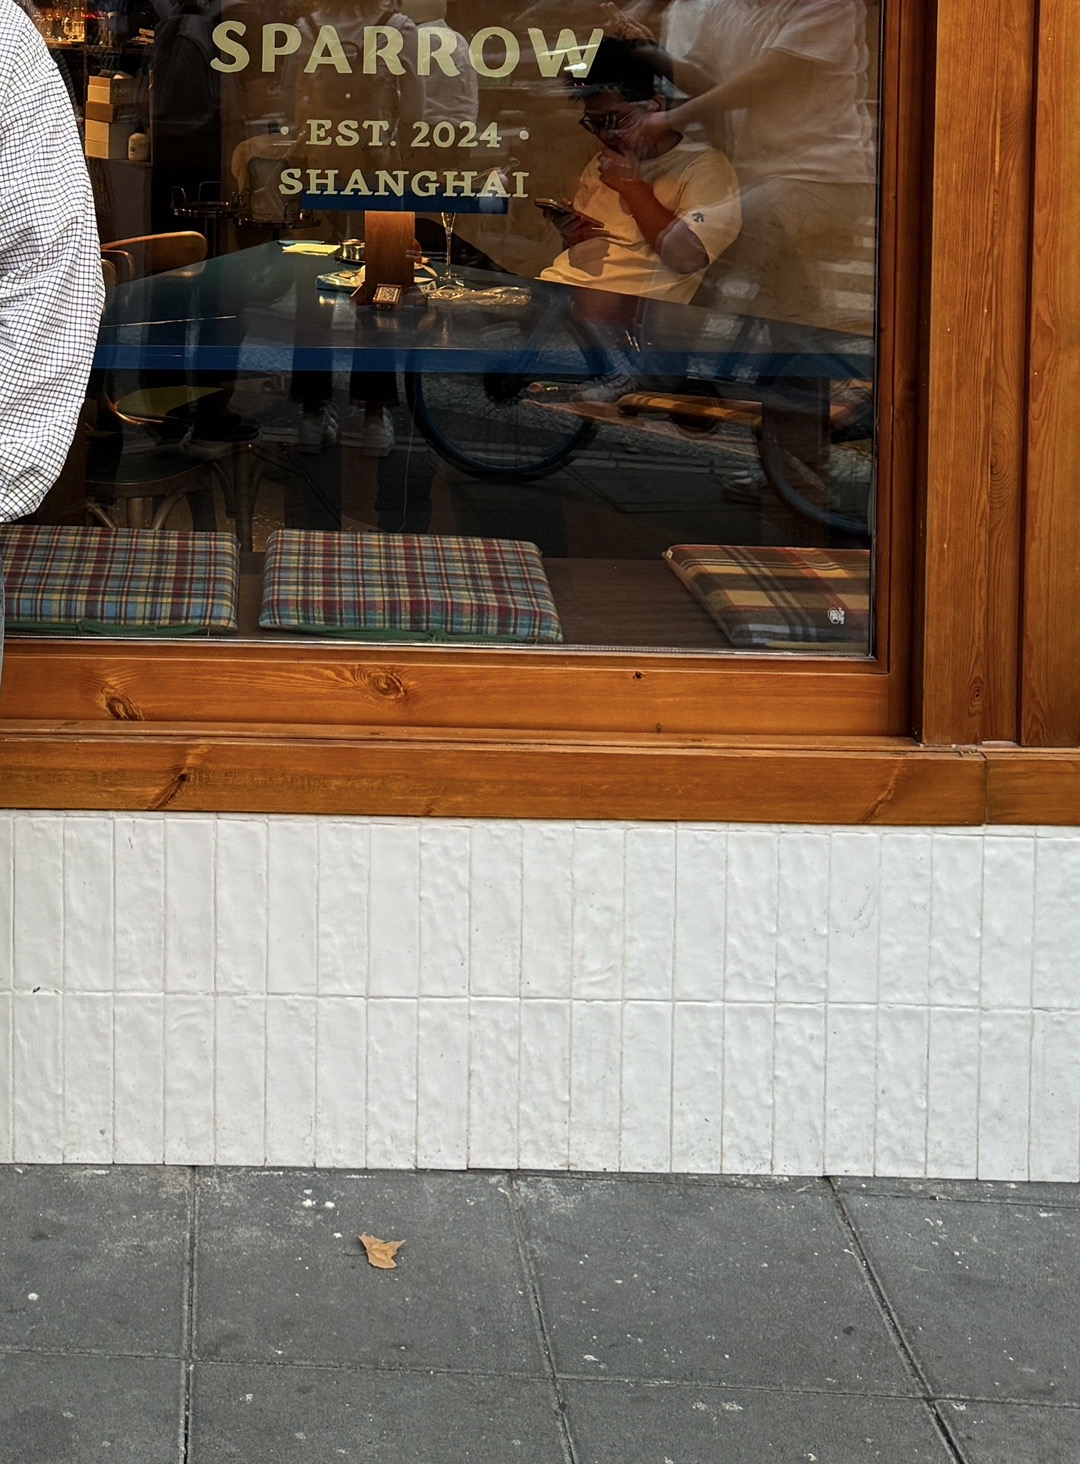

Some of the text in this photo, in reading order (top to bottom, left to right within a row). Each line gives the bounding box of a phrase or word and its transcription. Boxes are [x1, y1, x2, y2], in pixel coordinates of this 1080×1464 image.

[210, 20, 604, 79] SPARROW
[305, 119, 503, 149] EST. 2024
[279, 168, 529, 199] SHANGHAI
